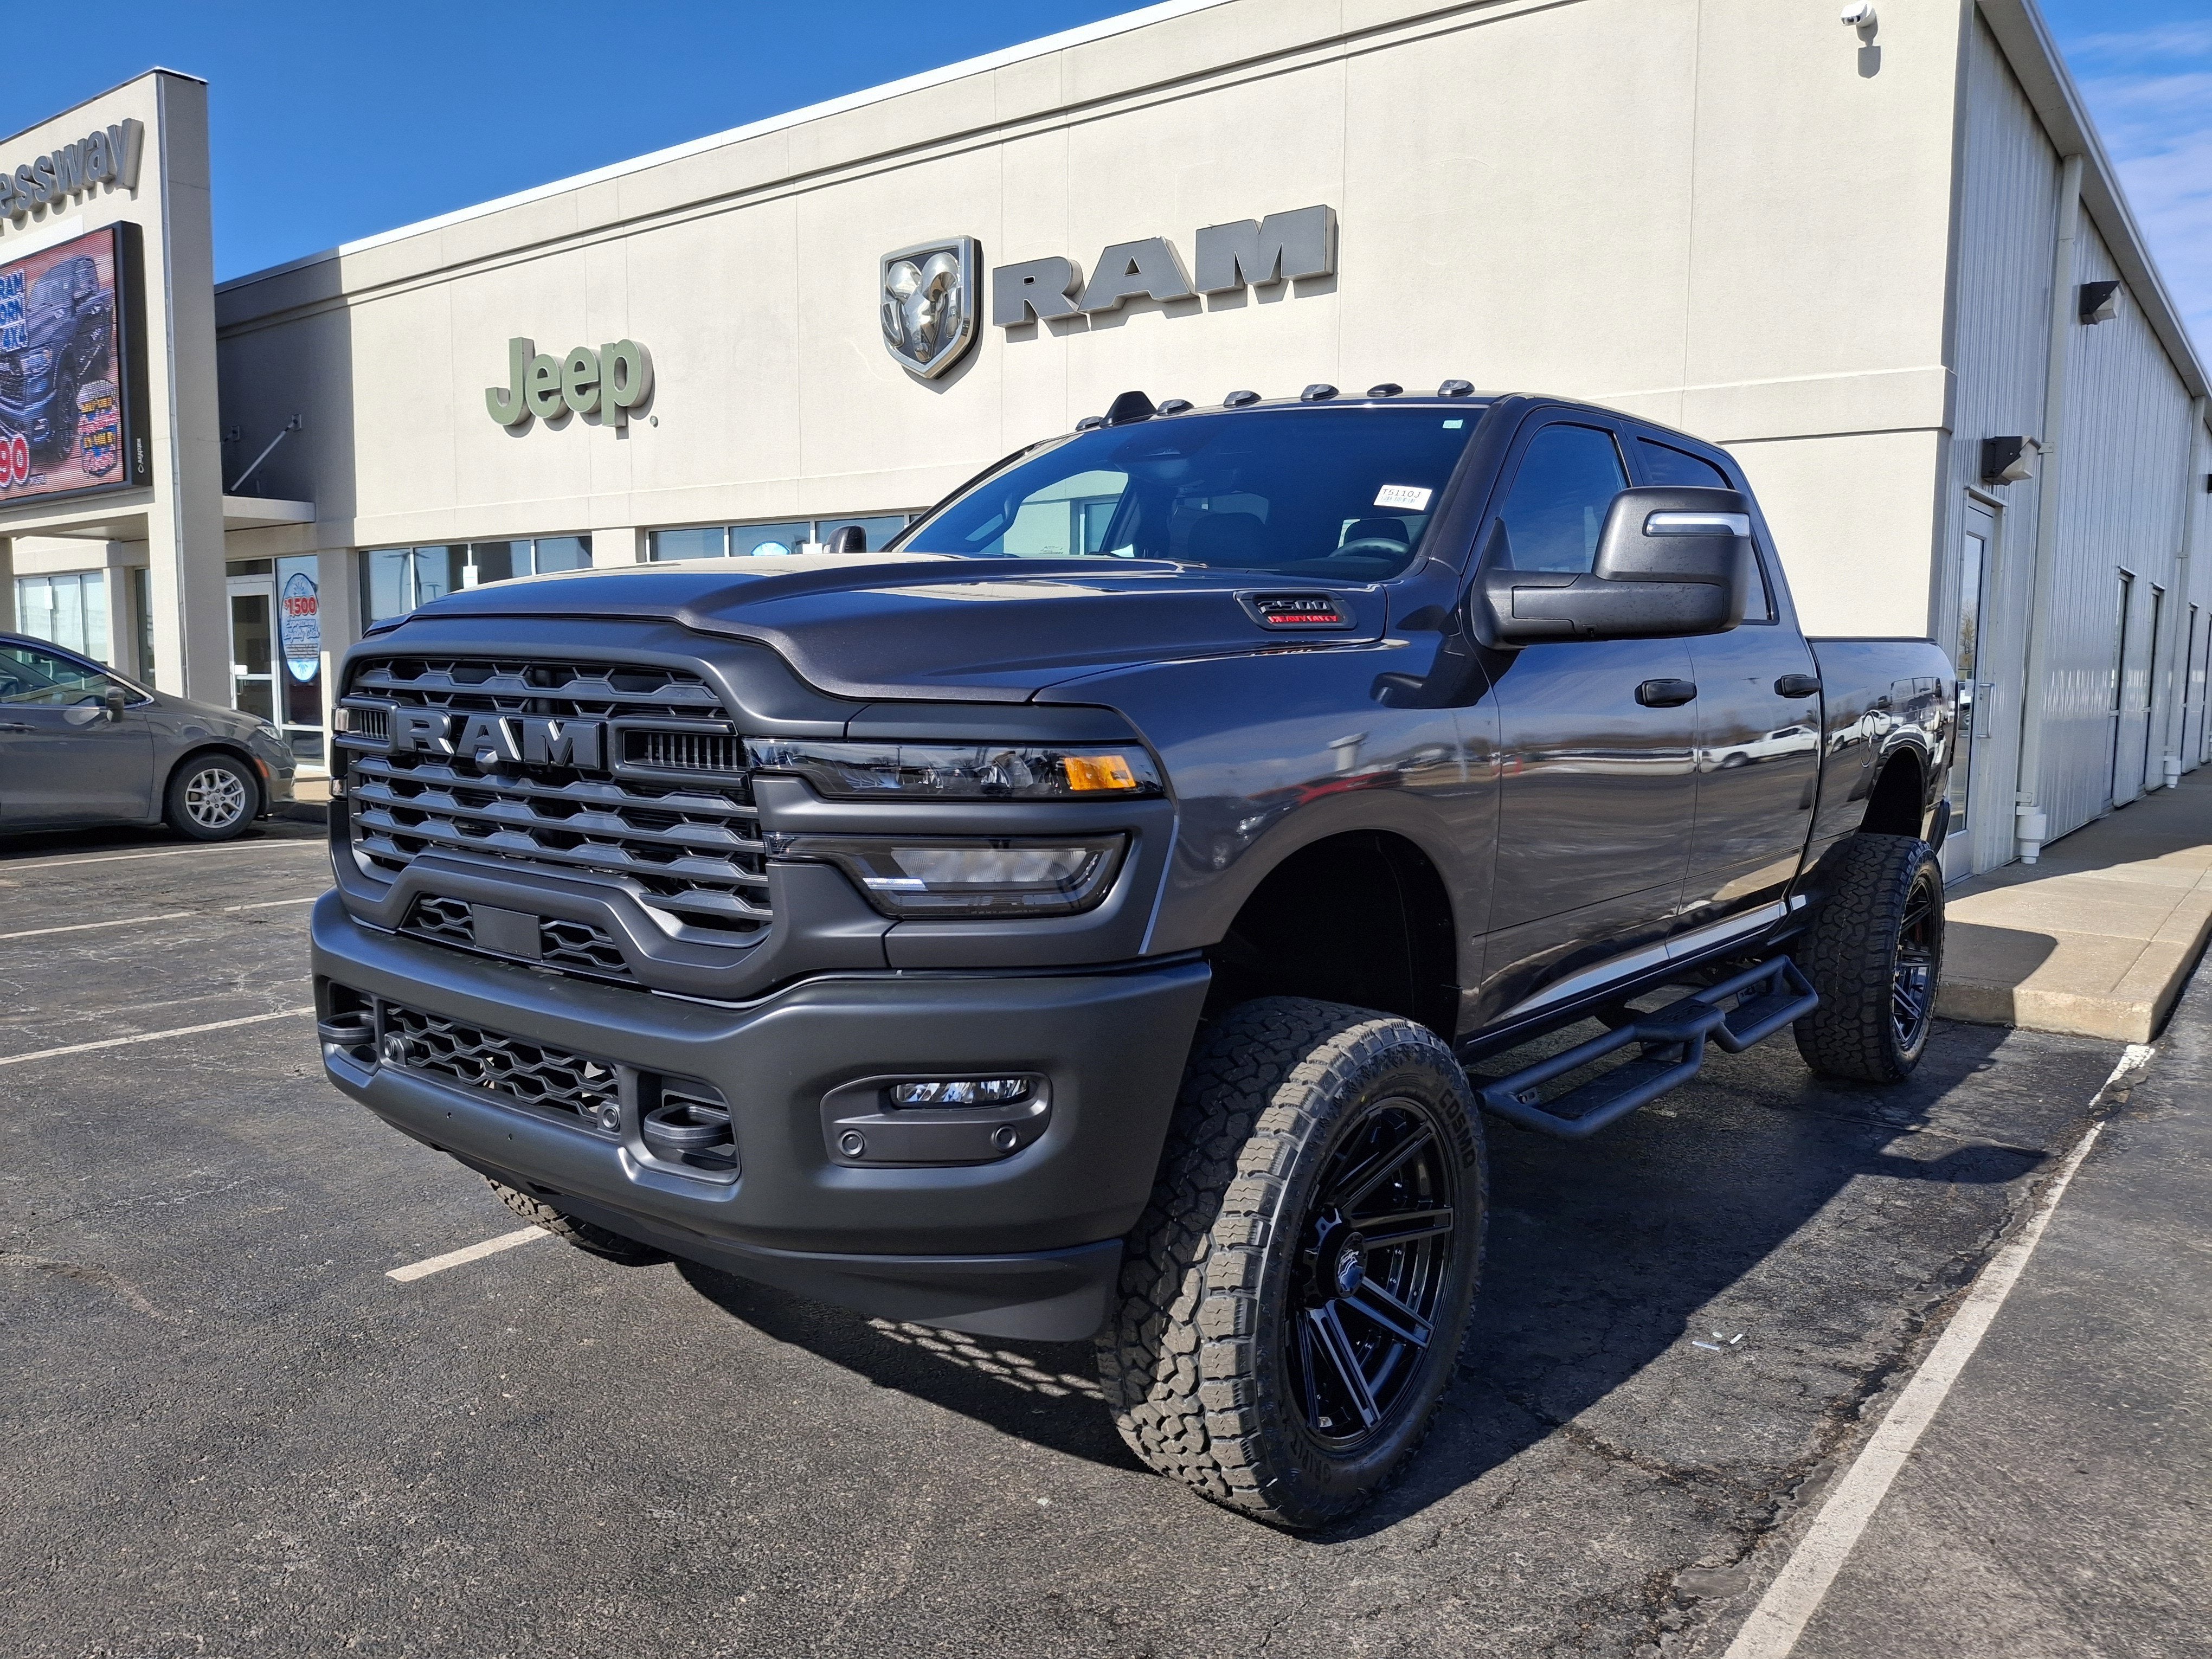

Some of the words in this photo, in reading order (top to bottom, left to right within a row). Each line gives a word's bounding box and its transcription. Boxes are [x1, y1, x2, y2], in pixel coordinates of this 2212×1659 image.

[993, 204, 1335, 327] RAM
[485, 337, 652, 428] Jeep
[1382, 488, 1421, 498] T5110J
[1258, 600, 1334, 614] 2500
[397, 709, 607, 770] RAM
[1438, 1088, 1476, 1169] COSMO
